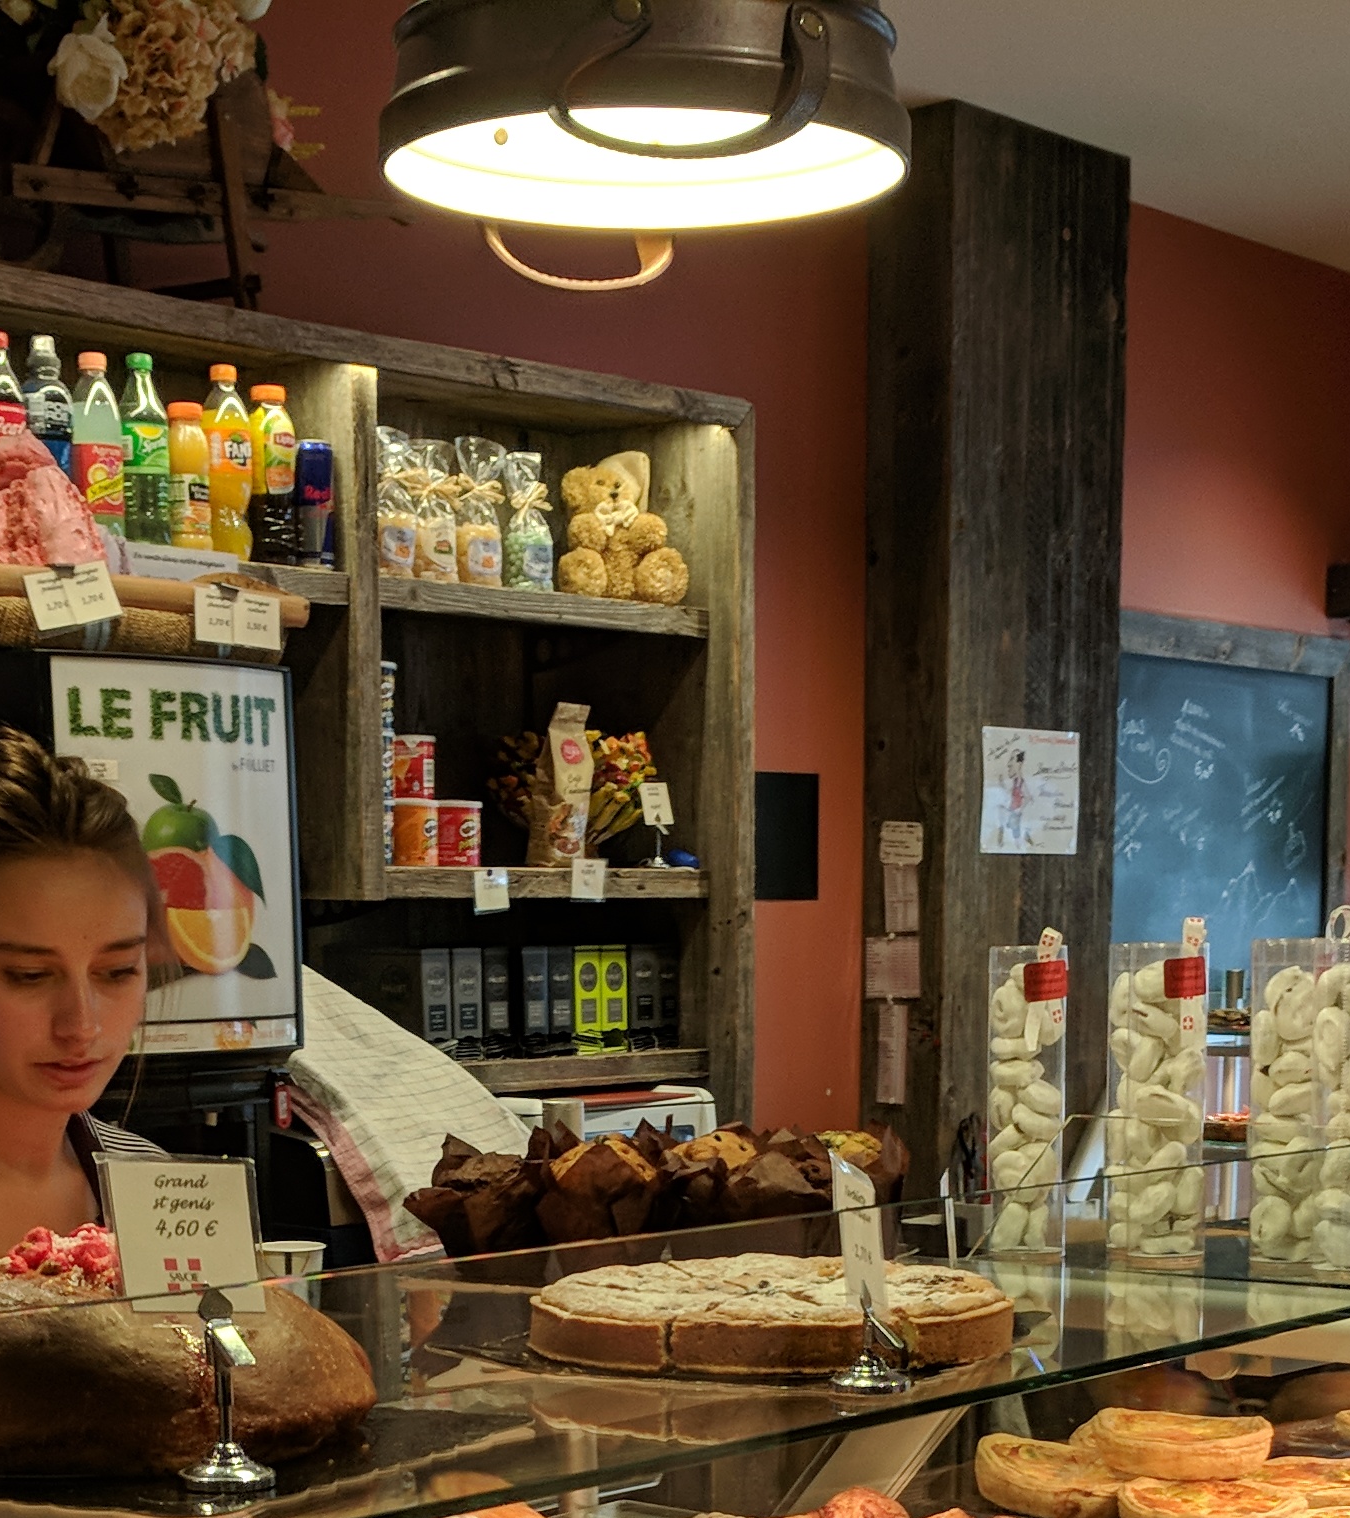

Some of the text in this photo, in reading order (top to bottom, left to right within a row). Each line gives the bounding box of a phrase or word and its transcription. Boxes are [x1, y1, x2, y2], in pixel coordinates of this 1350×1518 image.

[67, 686, 276, 747] LE FRUIT
[154, 1174, 209, 1189] Grand
[153, 1196, 215, 1213] st genis
[155, 1218, 219, 1239] 4,60 €
